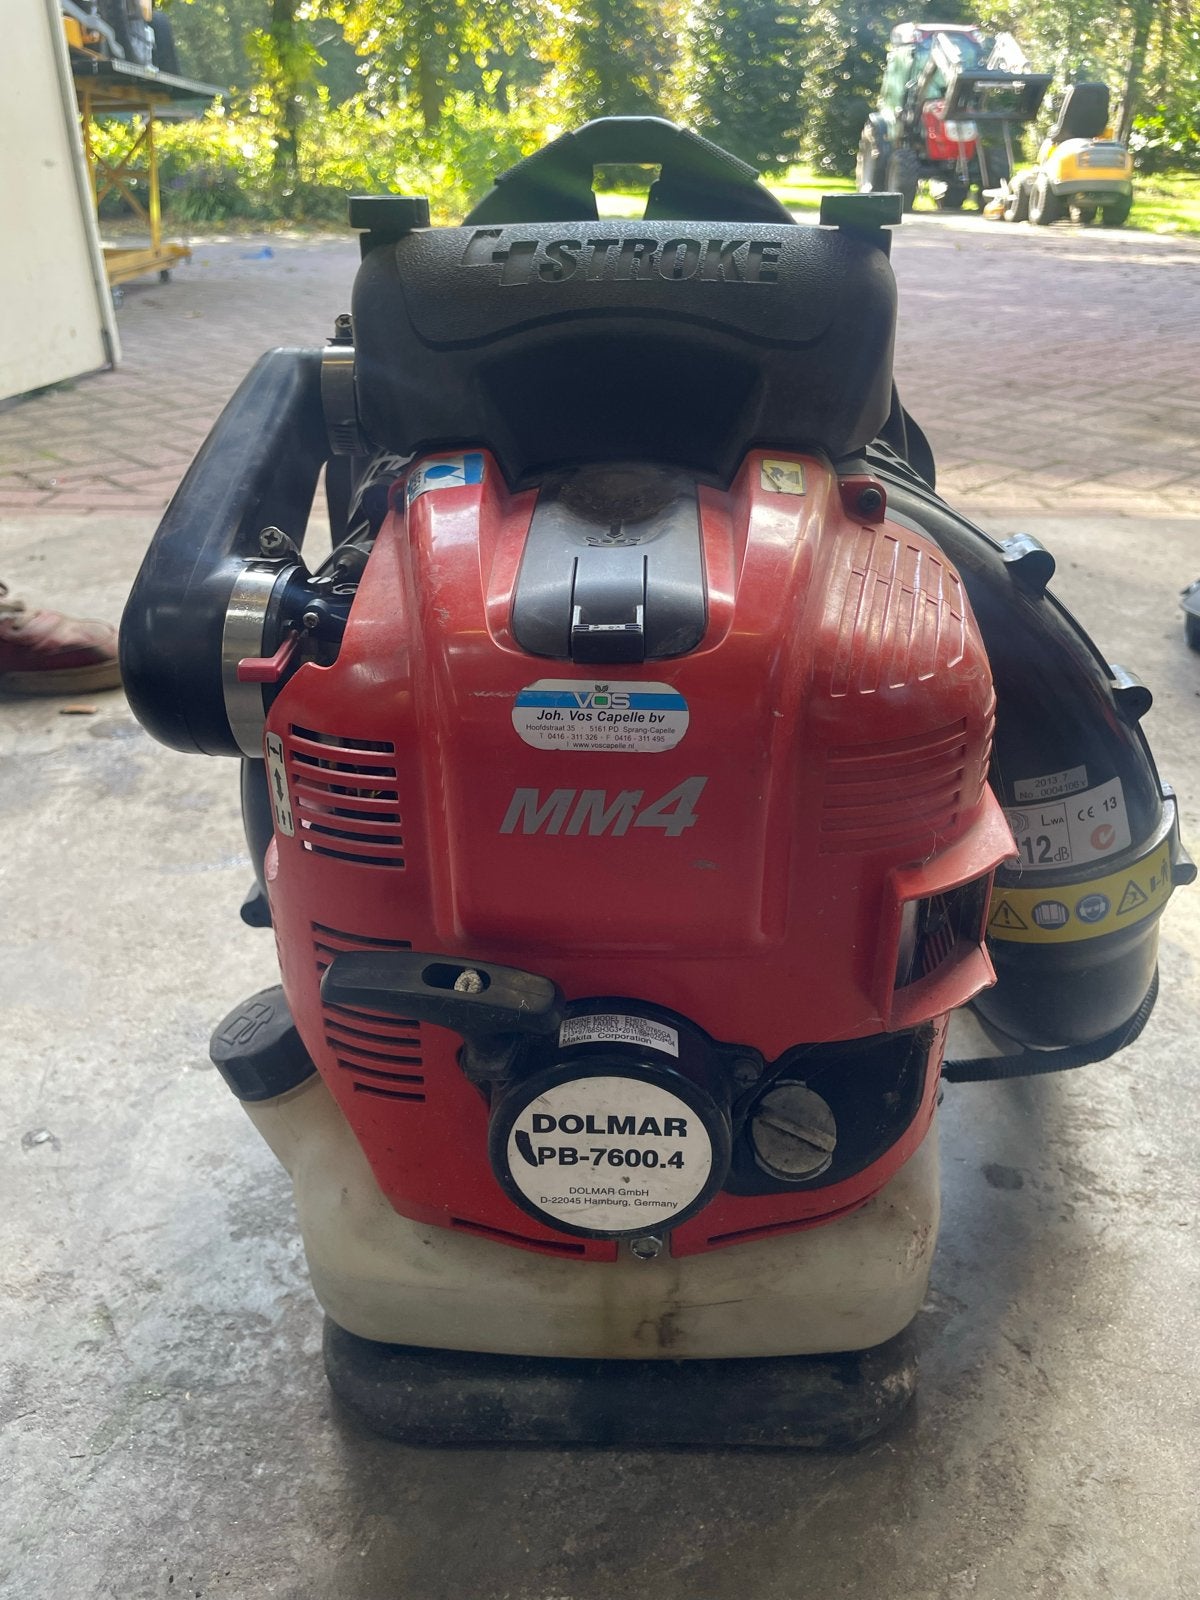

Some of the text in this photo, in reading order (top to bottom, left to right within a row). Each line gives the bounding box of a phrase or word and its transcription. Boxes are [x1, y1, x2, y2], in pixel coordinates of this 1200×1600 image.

[573, 691, 631, 710] VOS
[536, 709, 665, 724] Joh. Vos Capelle bv
[526, 724, 566, 733] Hoofdstraat
[566, 725, 576, 733] 35
[589, 725, 607, 733] 5161
[622, 726, 676, 735] Sprang-Capelle
[652, 735, 665, 743] 495
[1035, 776, 1058, 788] 2013
[499, 776, 709, 836] MM4
[1077, 796, 1118, 822] CE 13
[1015, 835, 1053, 864] 12
[562, 1032, 652, 1045] Makita Corporation
[532, 1114, 688, 1138] DOLMAR
[538, 1147, 685, 1169] PB-7600.4
[569, 1187, 649, 1197] DOLMAR GmbH
[540, 1197, 582, 1205] D-22045
[634, 1199, 678, 1209] Germany
